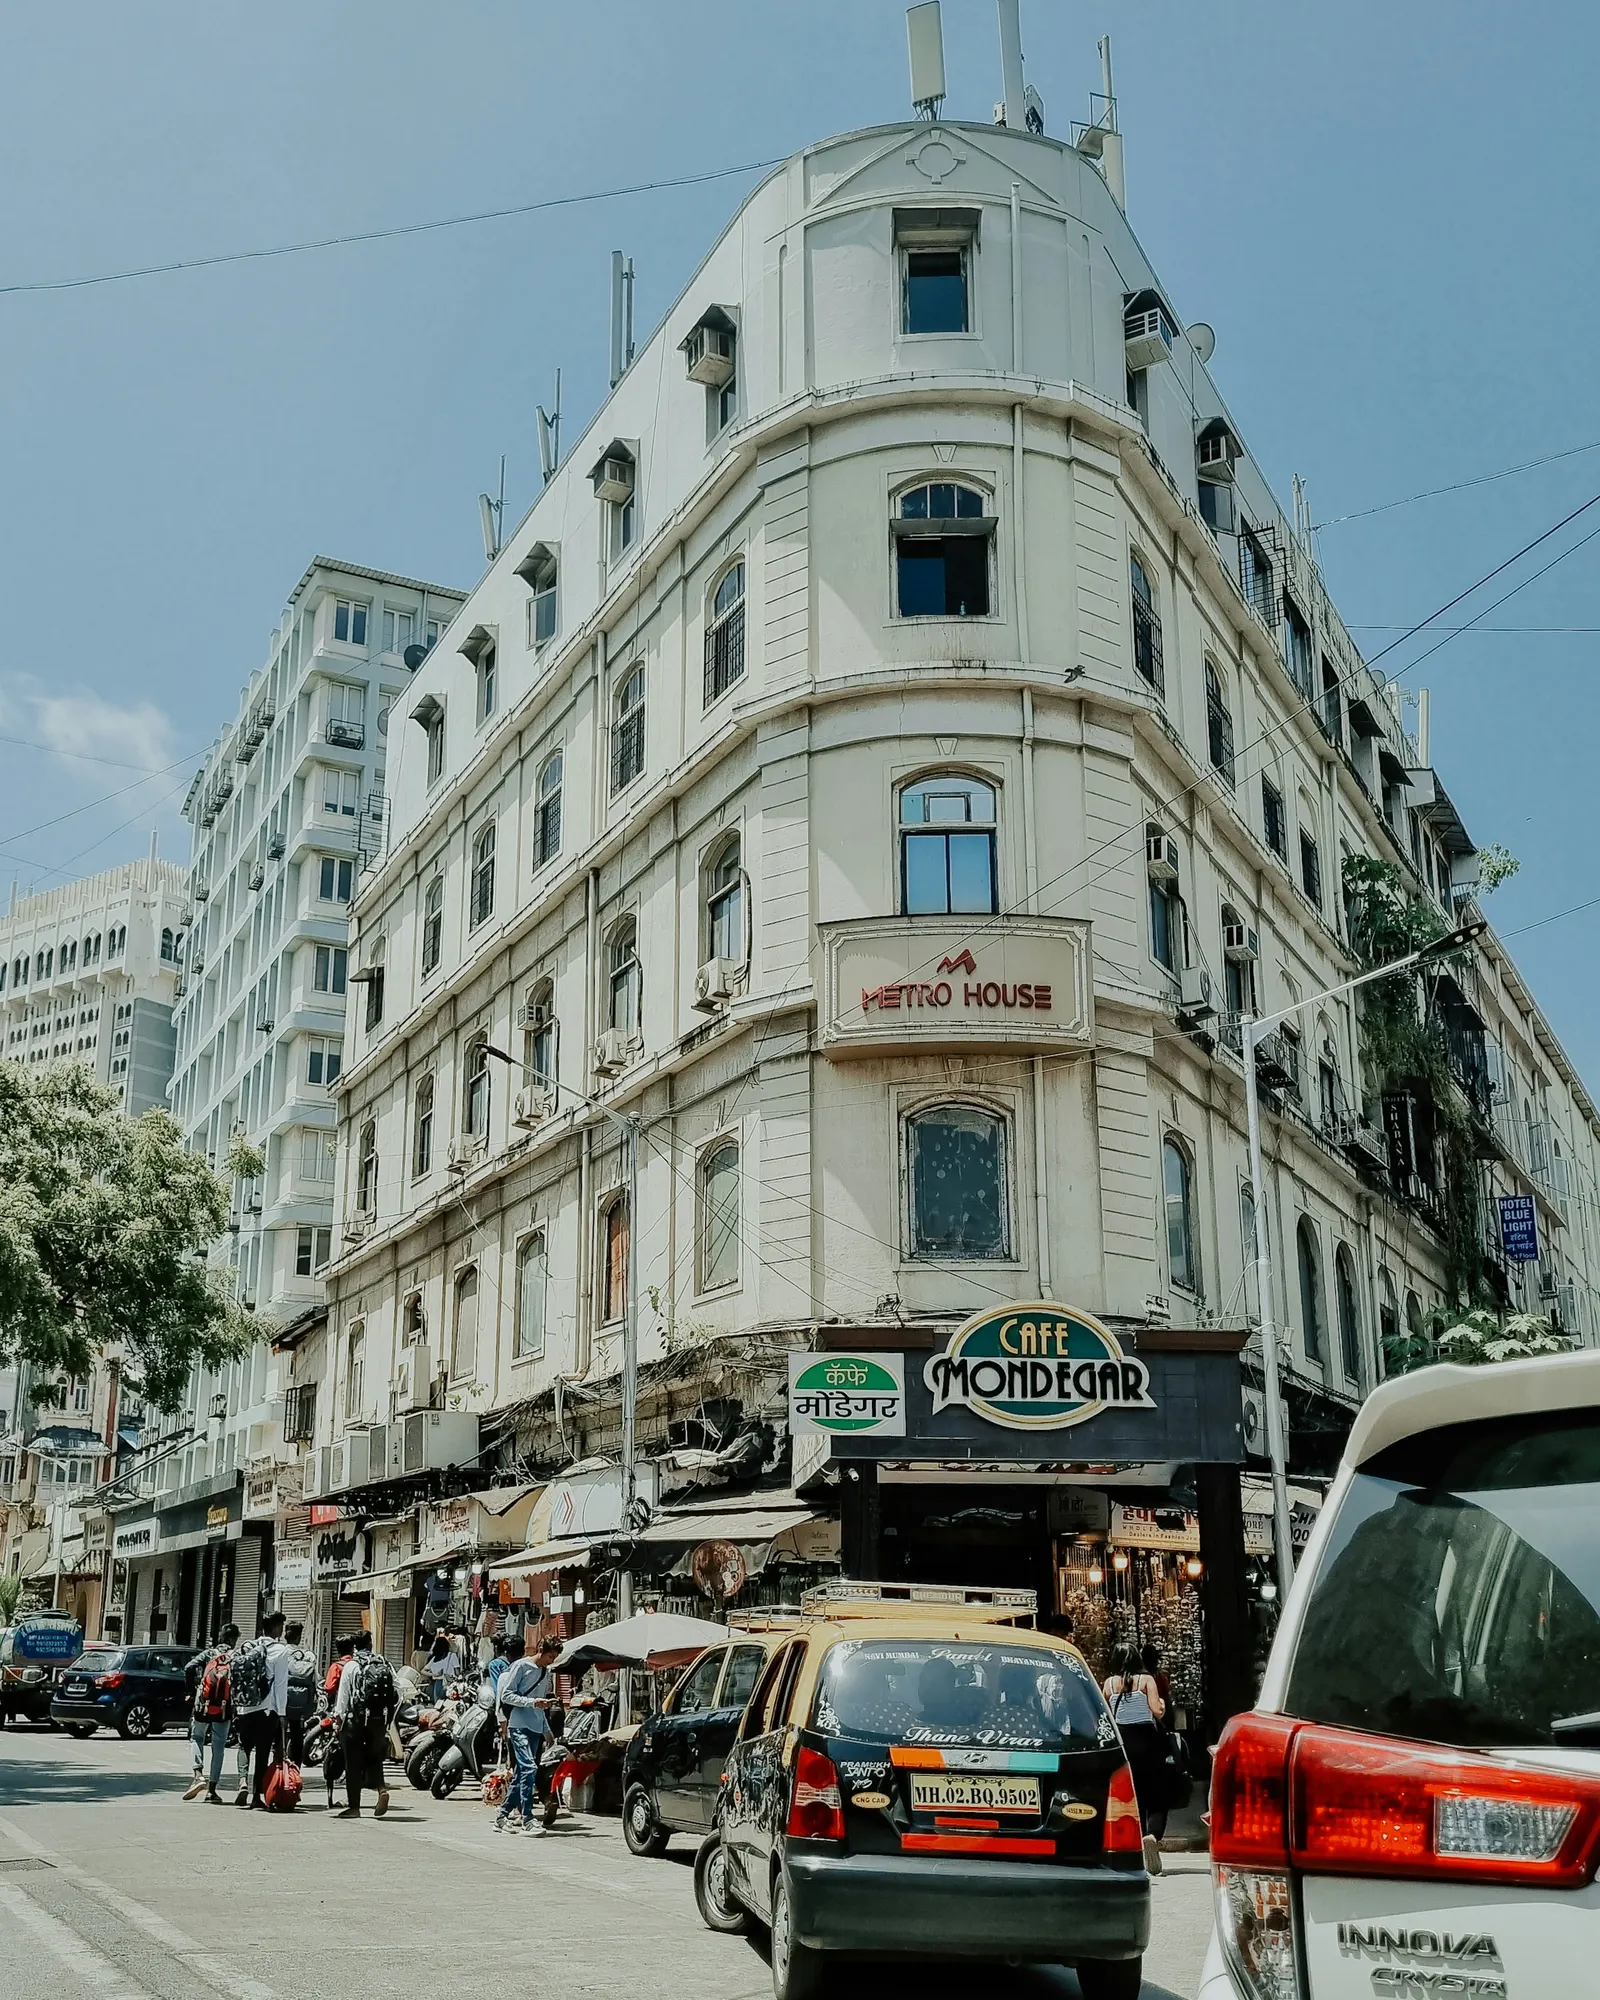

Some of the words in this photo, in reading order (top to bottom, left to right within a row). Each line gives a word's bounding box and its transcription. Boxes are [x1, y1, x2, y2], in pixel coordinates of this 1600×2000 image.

[861, 981, 952, 1010] METRO
[964, 982, 1052, 1009] HOUSE
[1500, 1199, 1532, 1210] HOTEL
[1504, 1210, 1530, 1220] BLUE
[1503, 1221, 1532, 1232] LIGHT
[1000, 1319, 1069, 1355] CAFE
[932, 1357, 1143, 1401] MONDEGAR
[793, 1391, 900, 1418] मोंडेगर
[864, 1652, 885, 1660] NAVI
[887, 1652, 919, 1660] MUMBAI
[1001, 1656, 1054, 1669] BHAYANDER
[902, 1726, 971, 1743] Thane
[976, 1730, 1043, 1747] Virar
[914, 1787, 1037, 1807] MH.02.BQ.9502
[1337, 1923, 1503, 1963] INNOVA
[1370, 1967, 1508, 1997] CRYSTA
